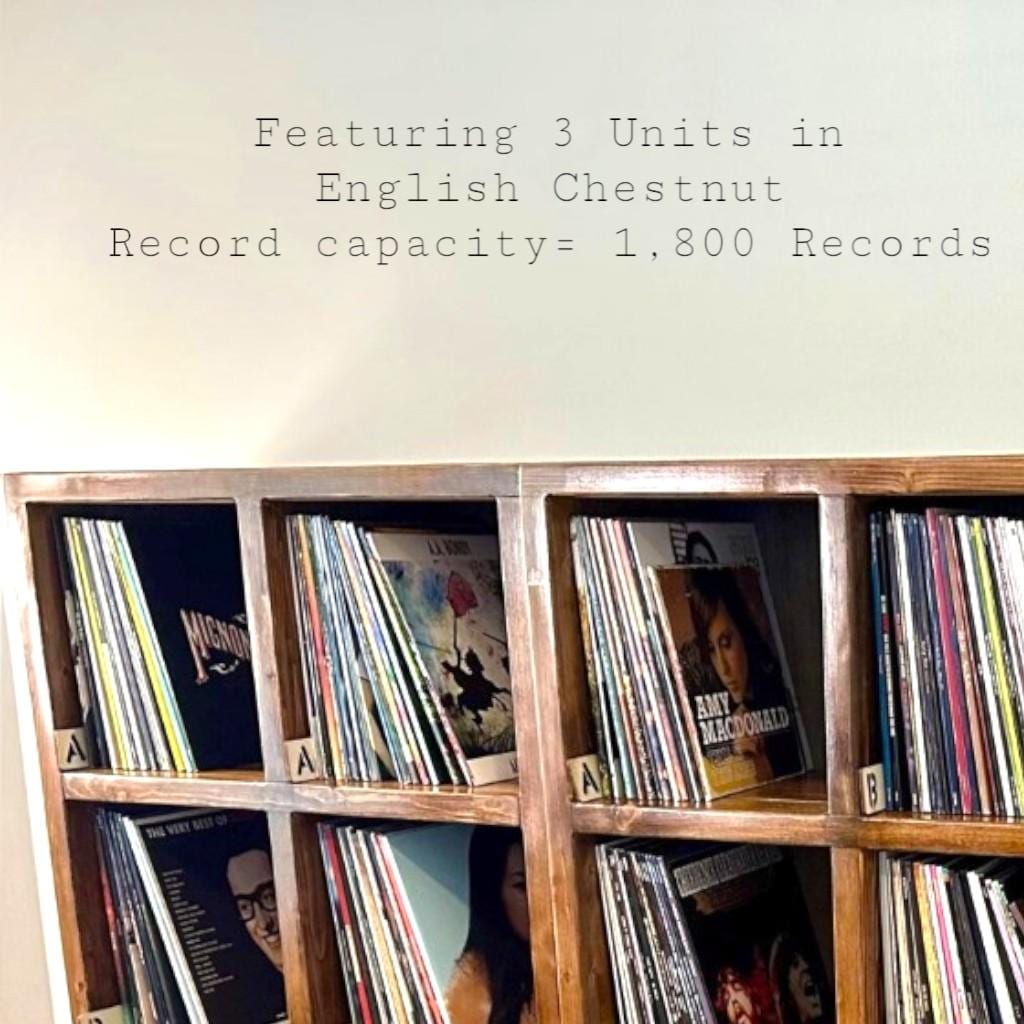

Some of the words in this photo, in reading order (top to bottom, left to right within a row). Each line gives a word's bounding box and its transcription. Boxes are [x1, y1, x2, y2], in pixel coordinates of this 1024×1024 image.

[695, 691, 730, 719] AMY
[699, 706, 790, 746] MACDONALD
[66, 734, 86, 763] A
[297, 746, 315, 775] A
[581, 762, 599, 795] A
[866, 773, 878, 809] B
